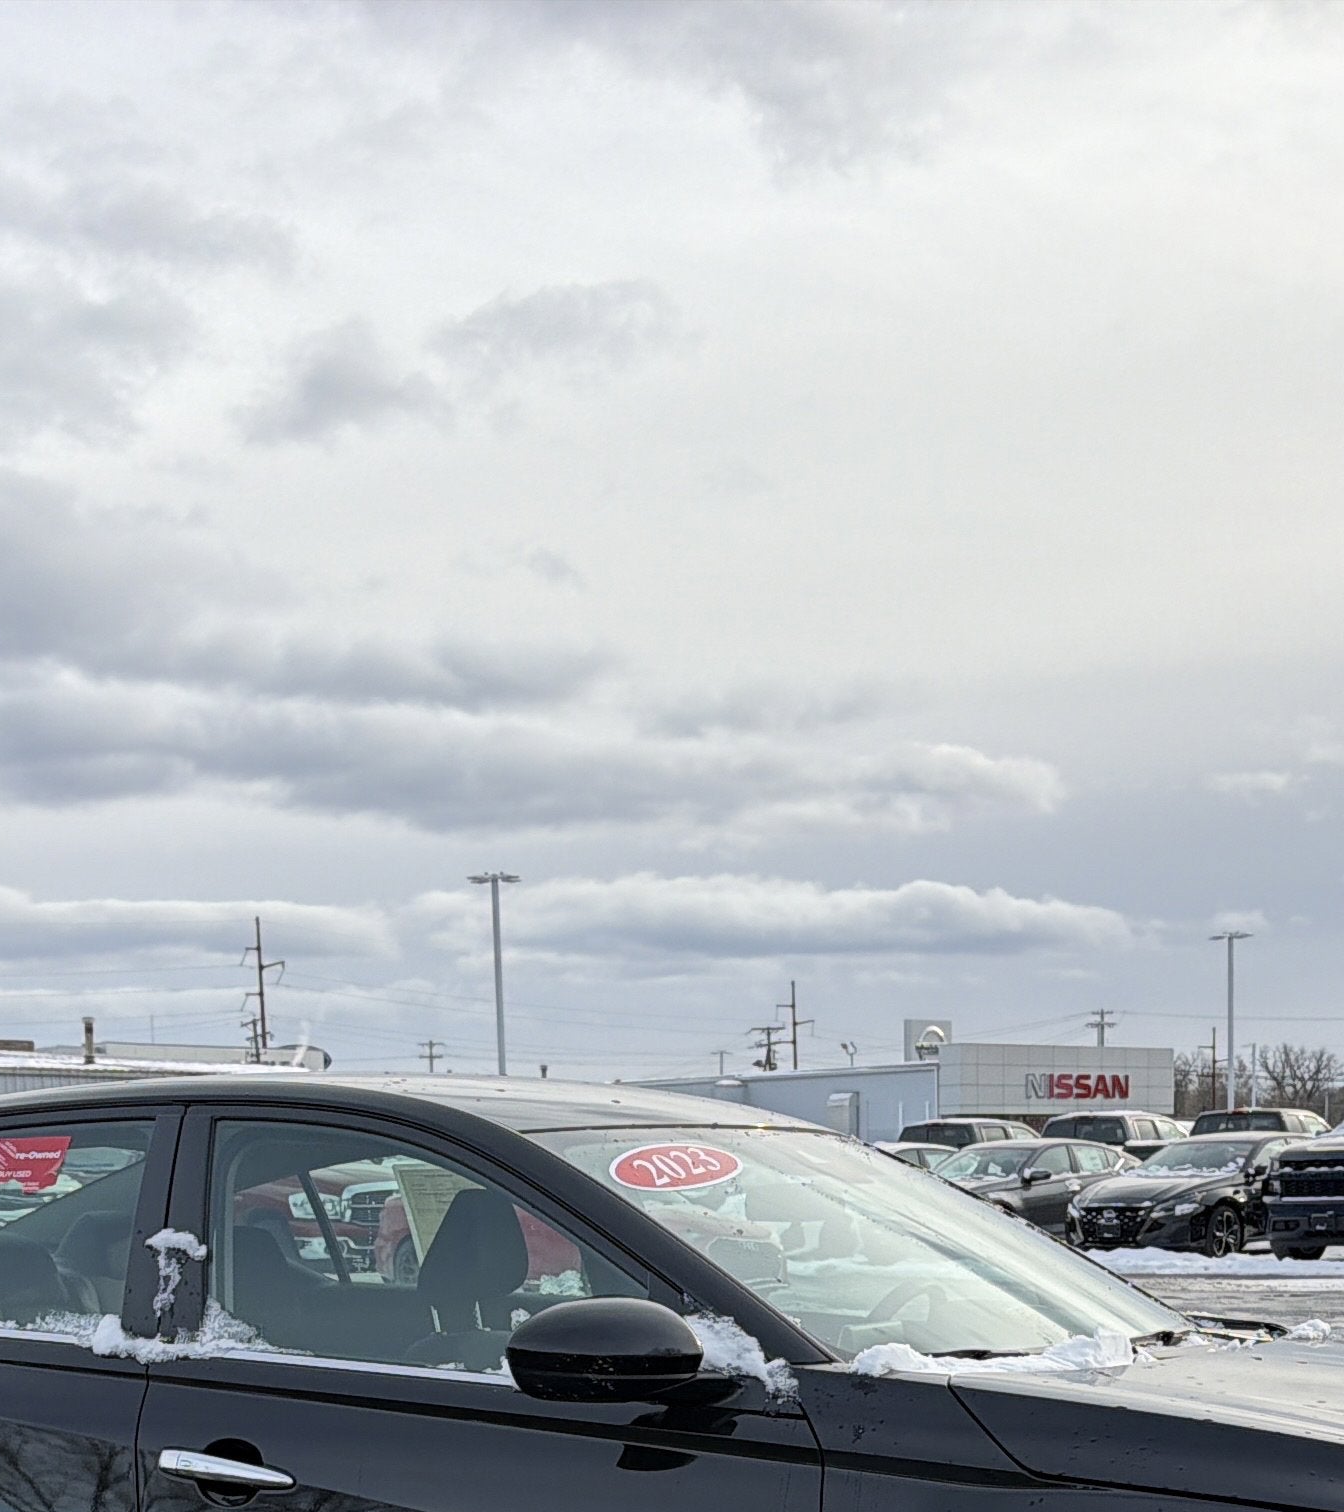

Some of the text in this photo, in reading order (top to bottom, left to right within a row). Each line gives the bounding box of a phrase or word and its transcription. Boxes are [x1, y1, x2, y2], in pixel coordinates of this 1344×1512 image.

[1025, 1072, 1130, 1100] NISSAN
[15, 1149, 62, 1160] re-Owned
[632, 1147, 721, 1186] 2023
